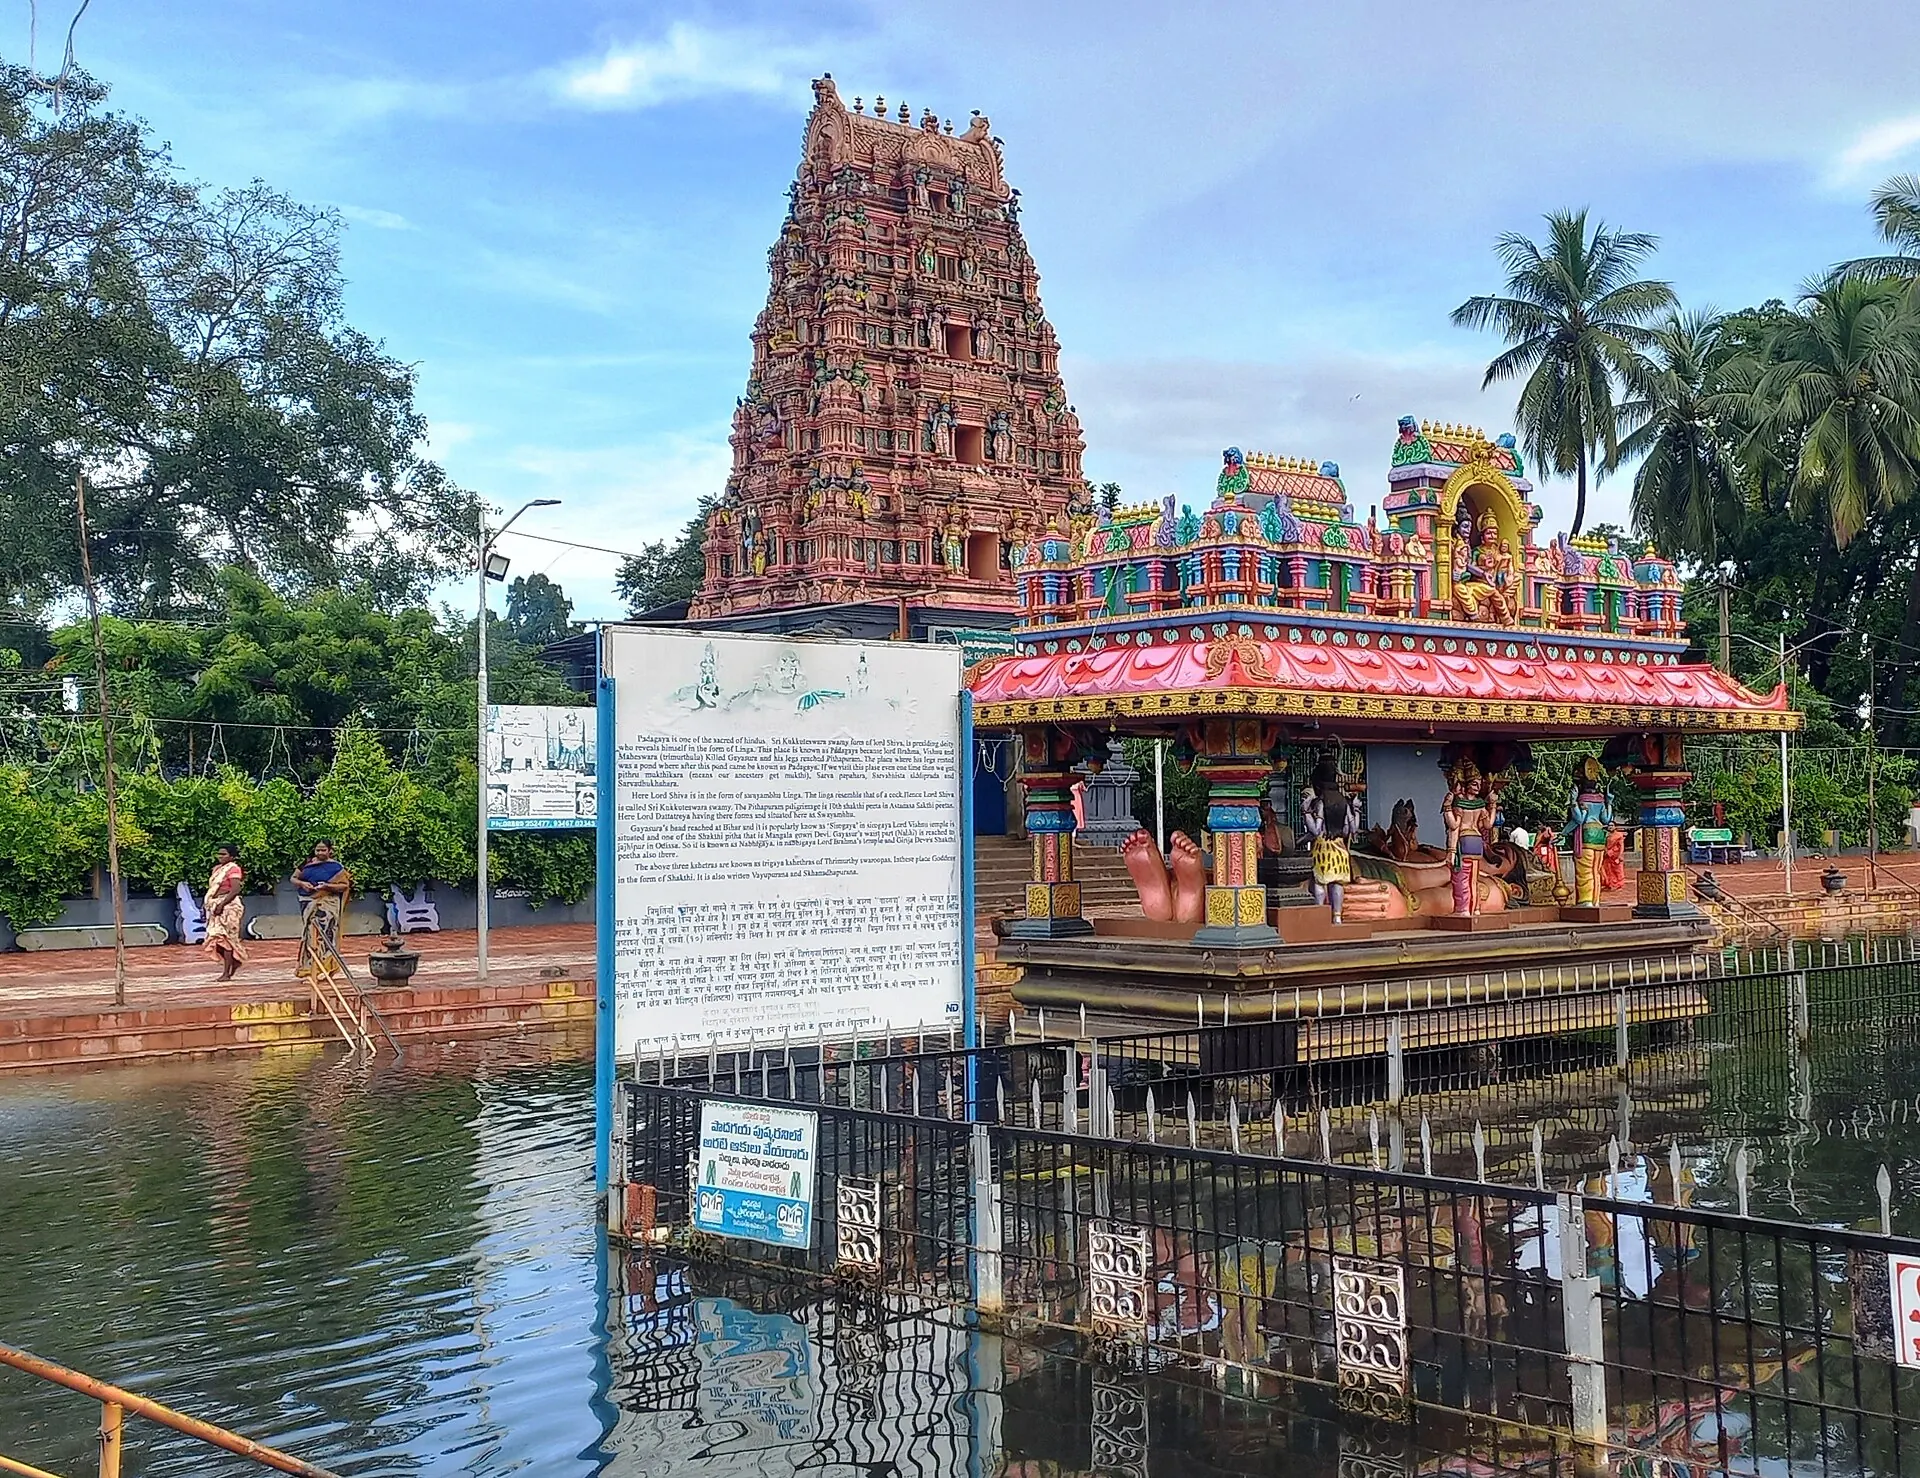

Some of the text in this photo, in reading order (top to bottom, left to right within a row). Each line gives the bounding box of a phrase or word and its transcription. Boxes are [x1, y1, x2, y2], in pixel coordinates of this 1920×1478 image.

[631, 791, 649, 799] Here
[650, 791, 667, 799] Lord
[668, 791, 688, 799] Shiva
[689, 791, 696, 799] is
[945, 1003, 959, 1013] ND
[700, 1192, 724, 1210] CMR
[778, 1204, 803, 1224] CMR
